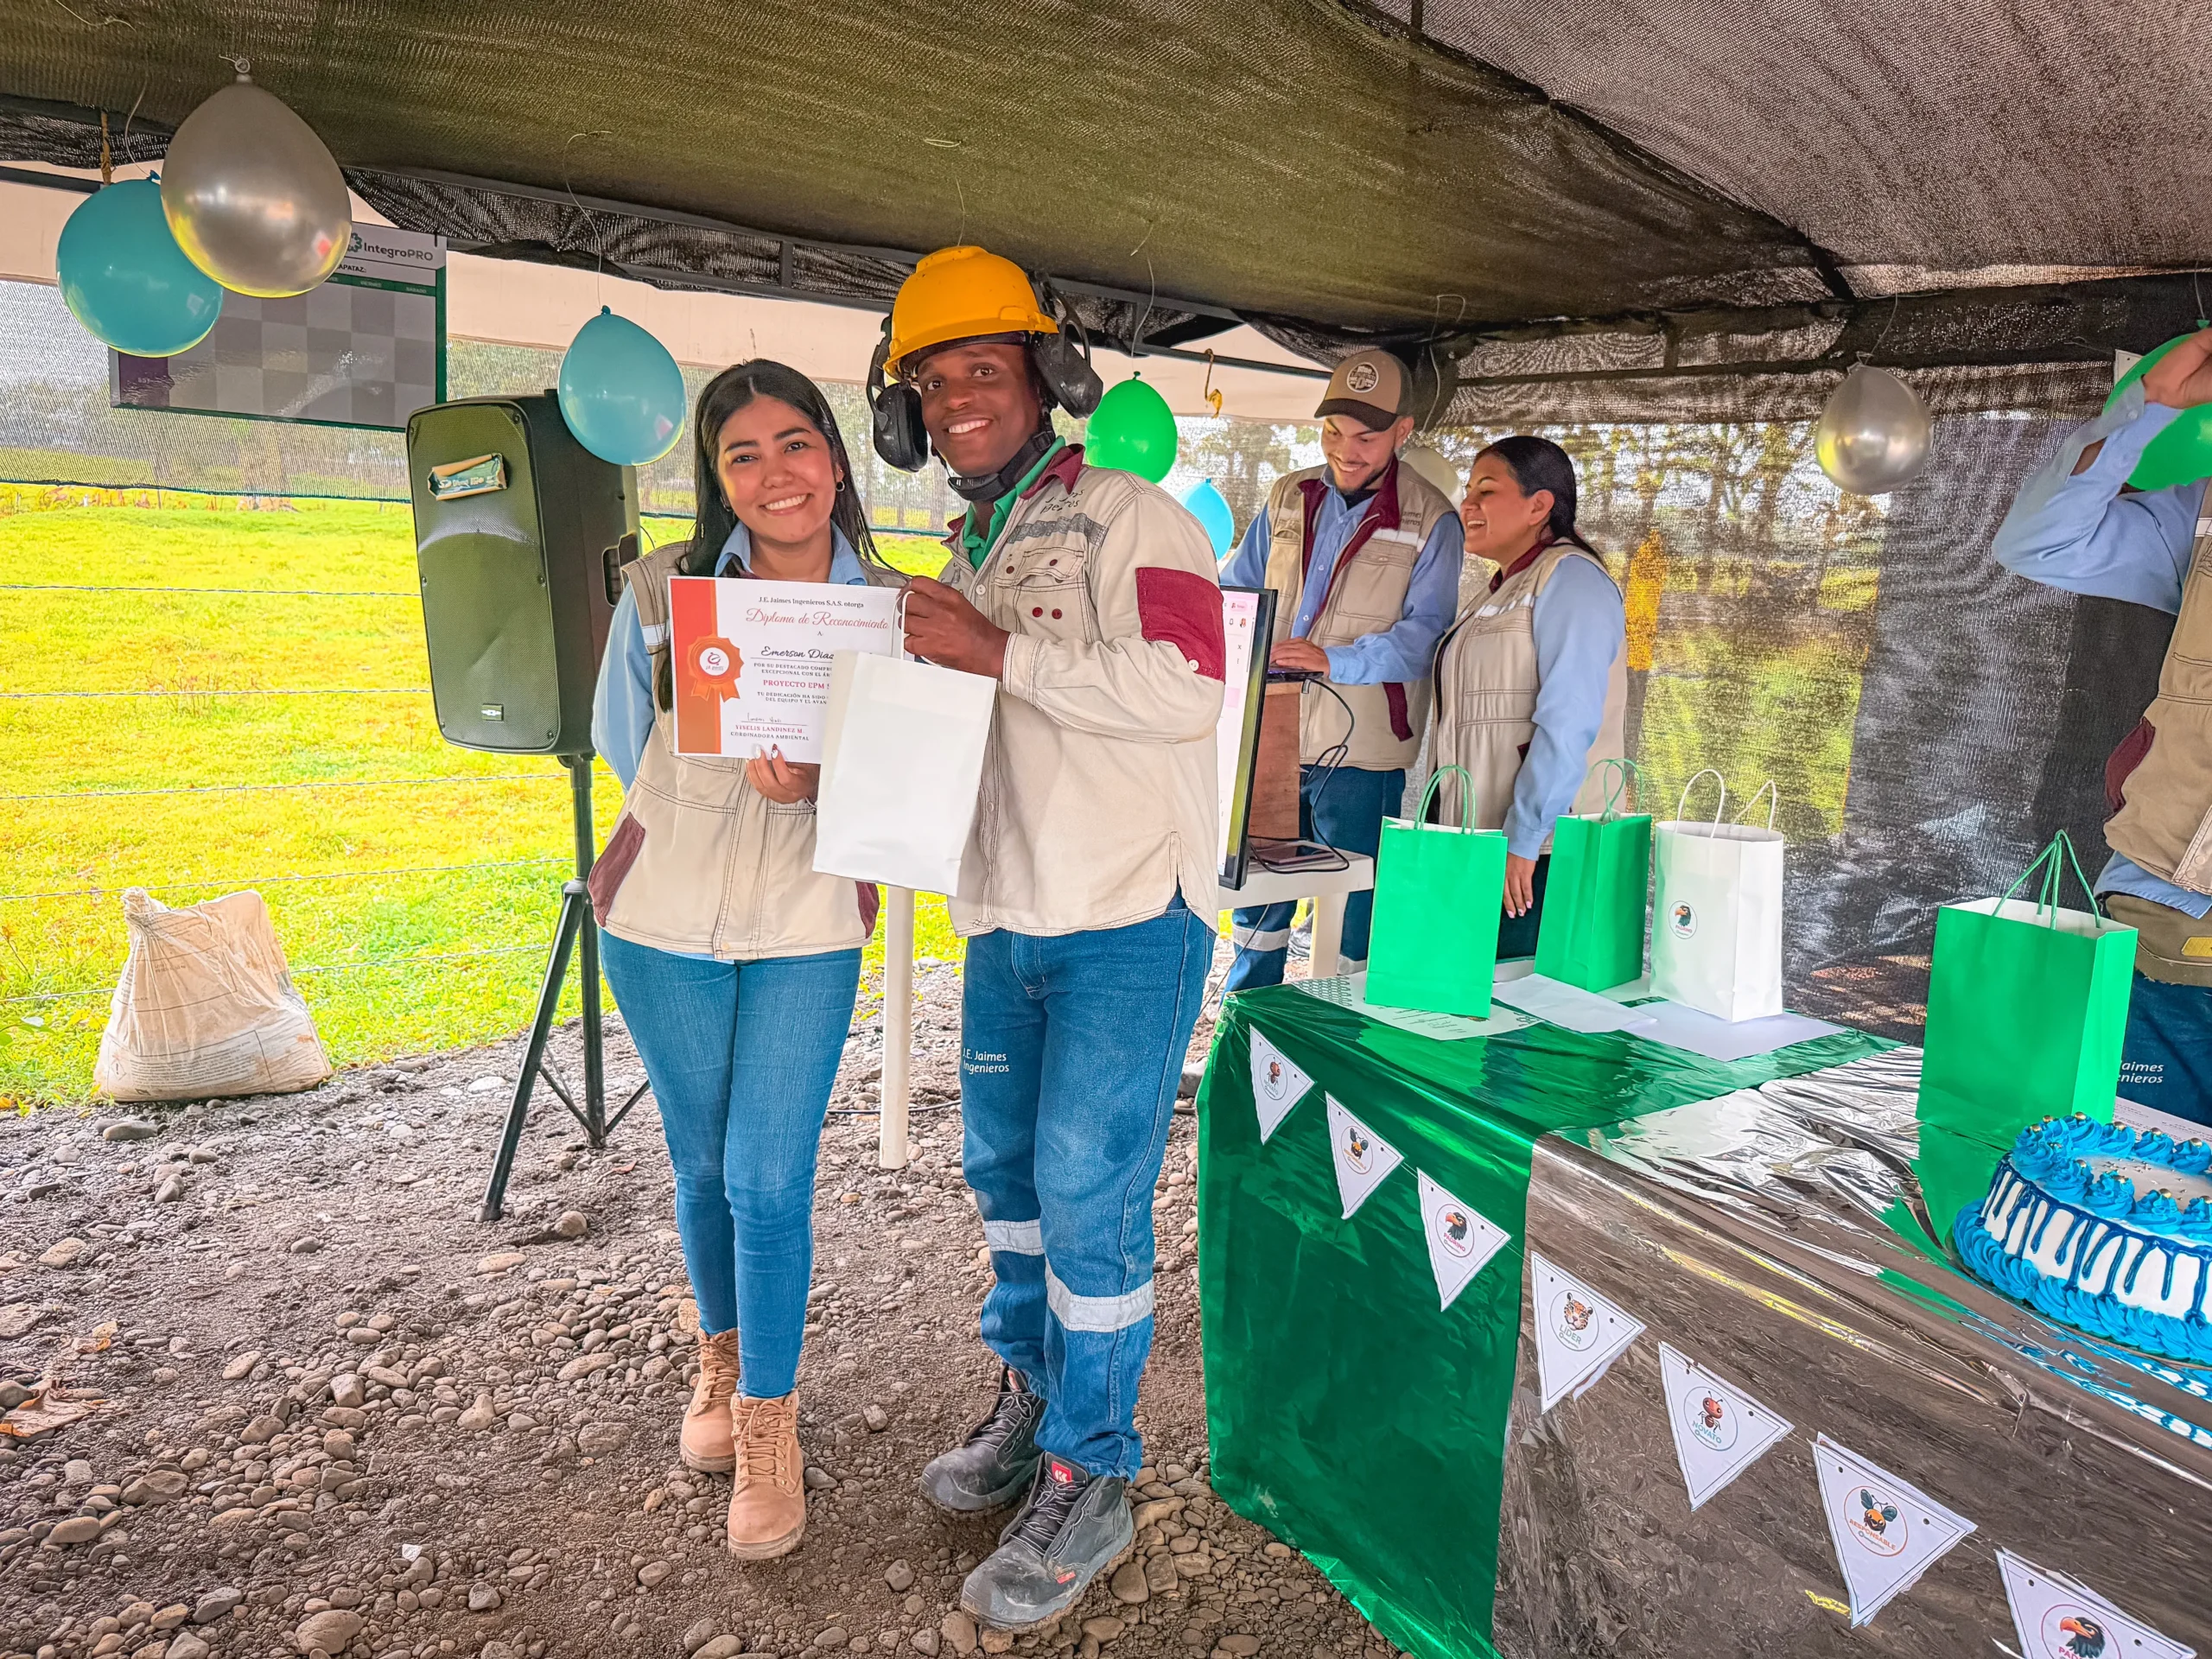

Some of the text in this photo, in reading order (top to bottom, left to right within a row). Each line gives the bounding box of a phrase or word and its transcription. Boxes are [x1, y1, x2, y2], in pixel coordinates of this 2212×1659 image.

[364, 242, 434, 261] IntegroPRO
[746, 608, 889, 629] Diploma de Reconocimiento
[761, 646, 806, 658] Emerson
[763, 680, 806, 688] PROYECTO
[974, 1050, 1007, 1062] Jaimes
[963, 1060, 1009, 1075] Ingenieros
[2120, 1060, 2164, 1073] aimes
[1443, 1232, 1466, 1252] PADRINO
[1692, 1421, 1722, 1444] NOVATO
[1850, 1518, 1897, 1551] RESPONSABLE
